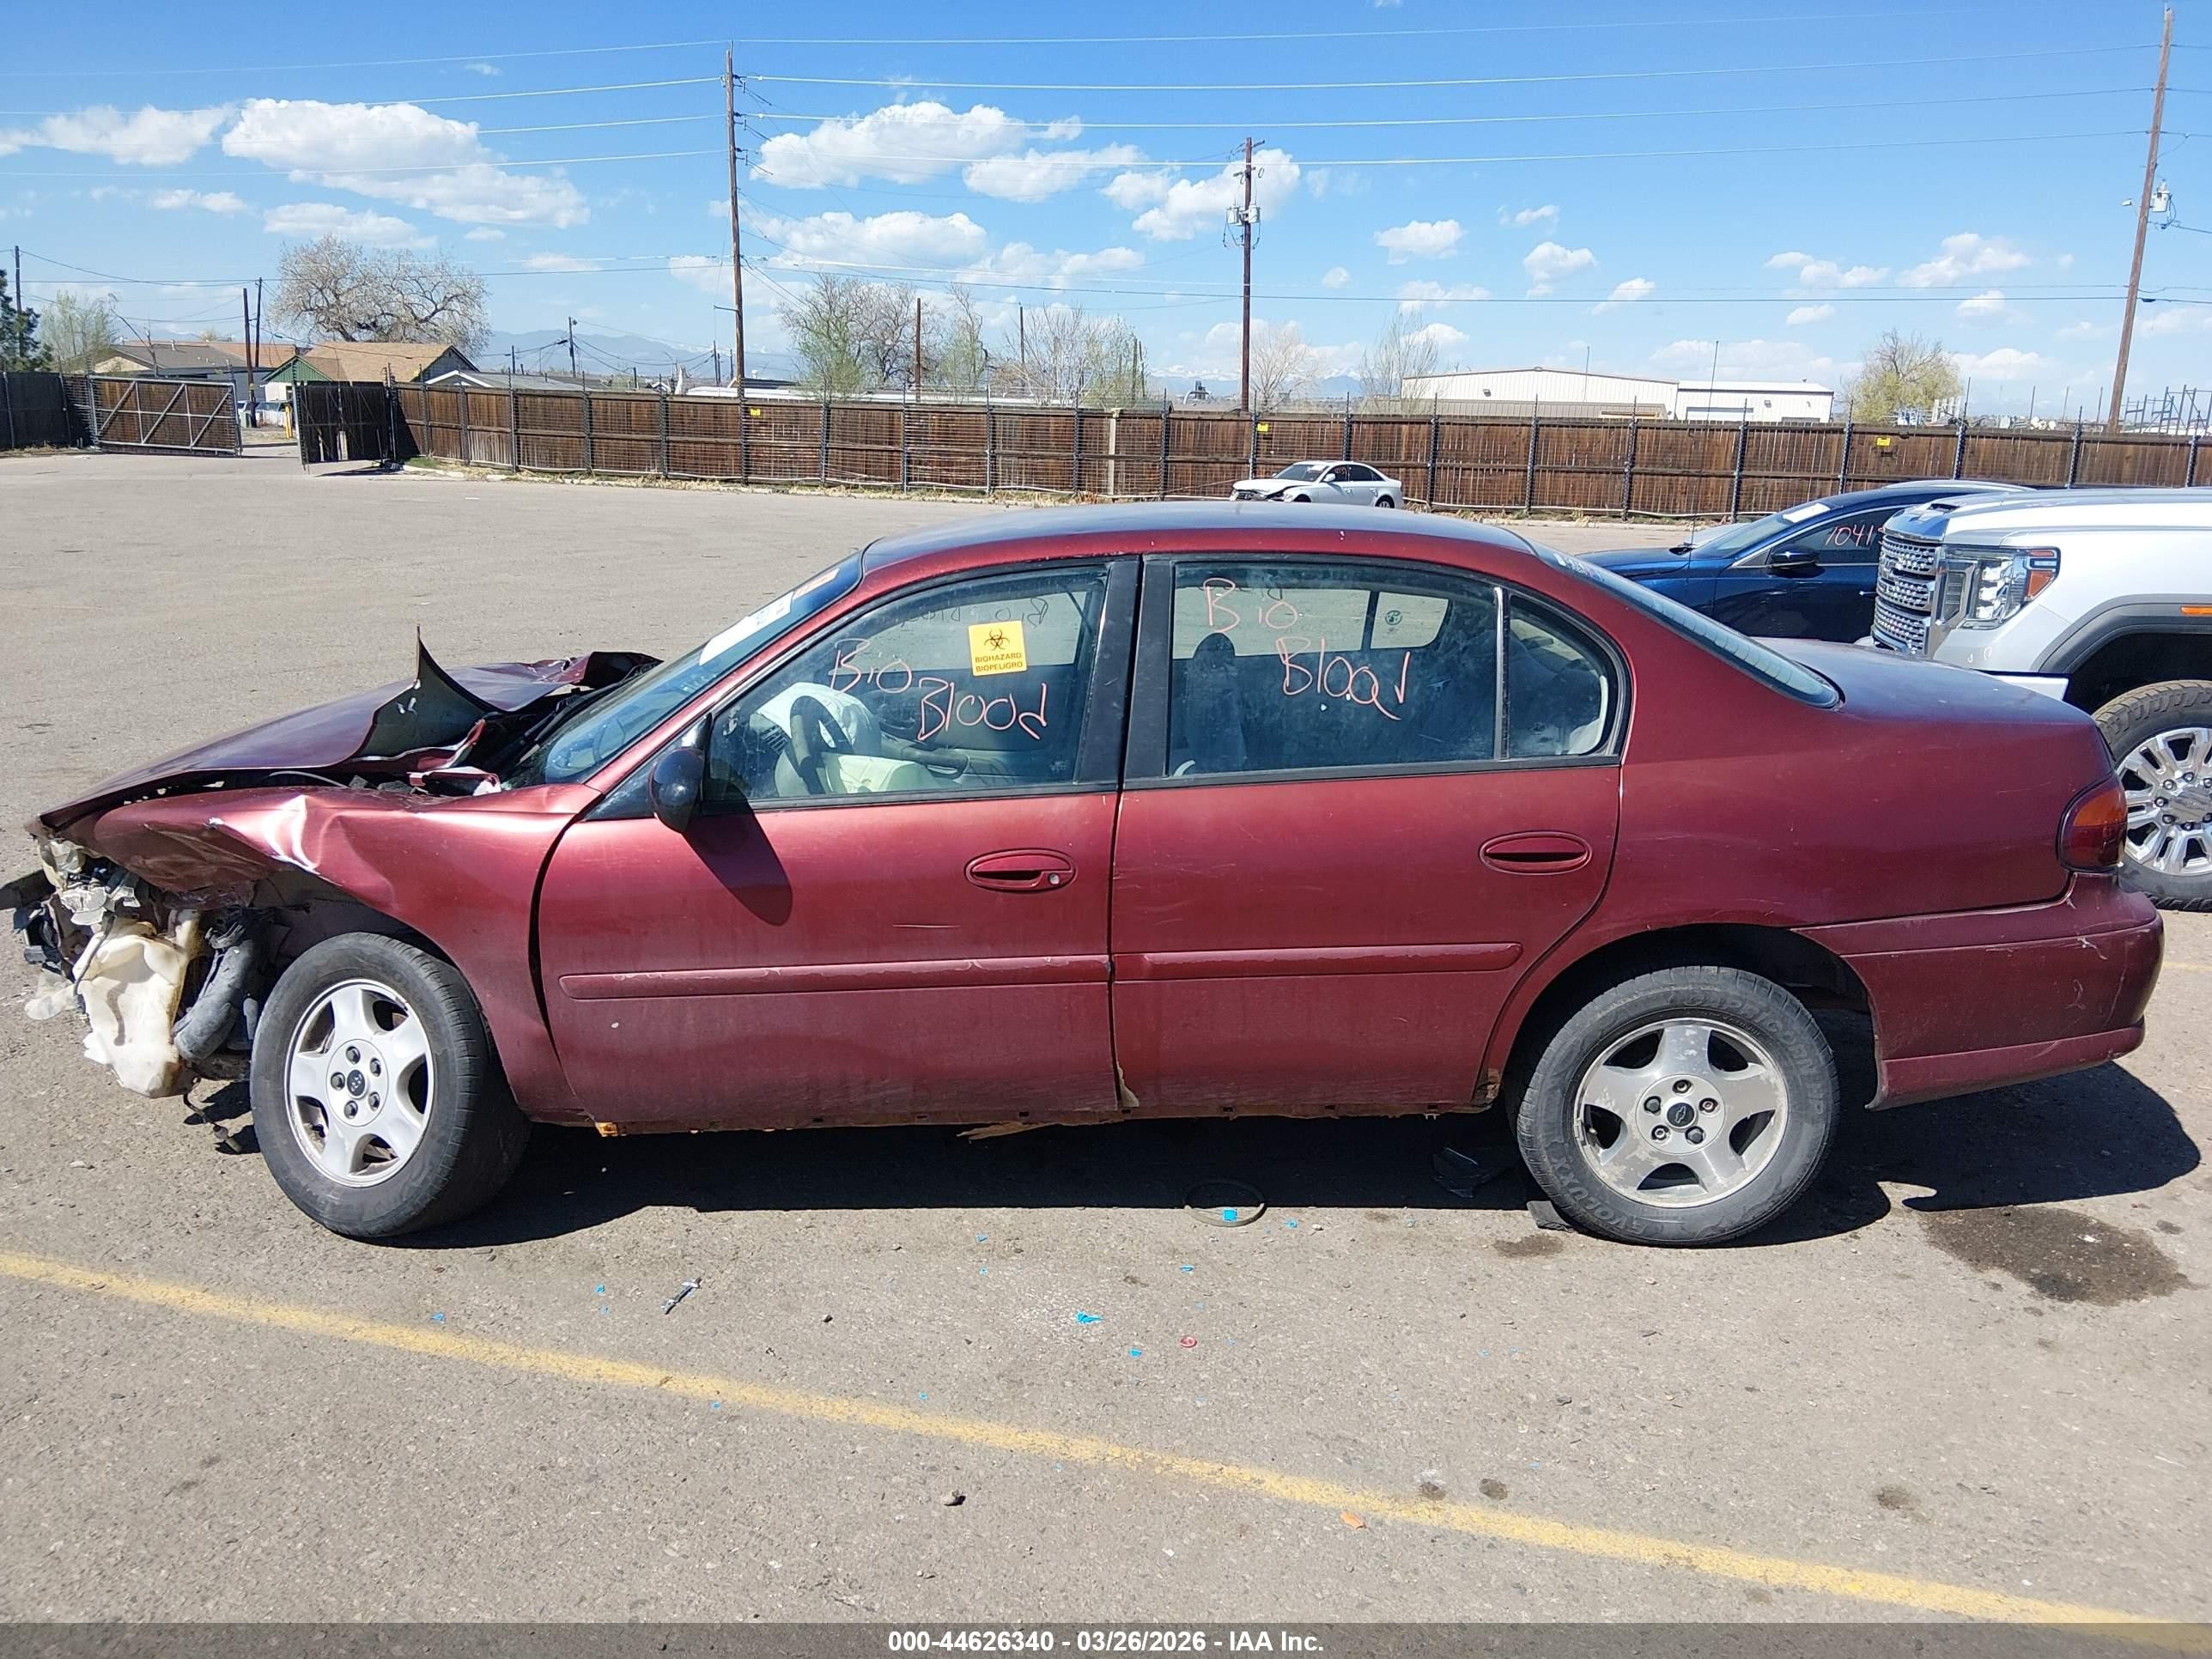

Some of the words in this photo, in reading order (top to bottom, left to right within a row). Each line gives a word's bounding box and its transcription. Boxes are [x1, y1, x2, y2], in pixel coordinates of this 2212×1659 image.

[975, 652, 1023, 664] BIOHAZARD
[975, 661, 1024, 673] BIOPELIGRO
[916, 677, 1048, 741] Blood
